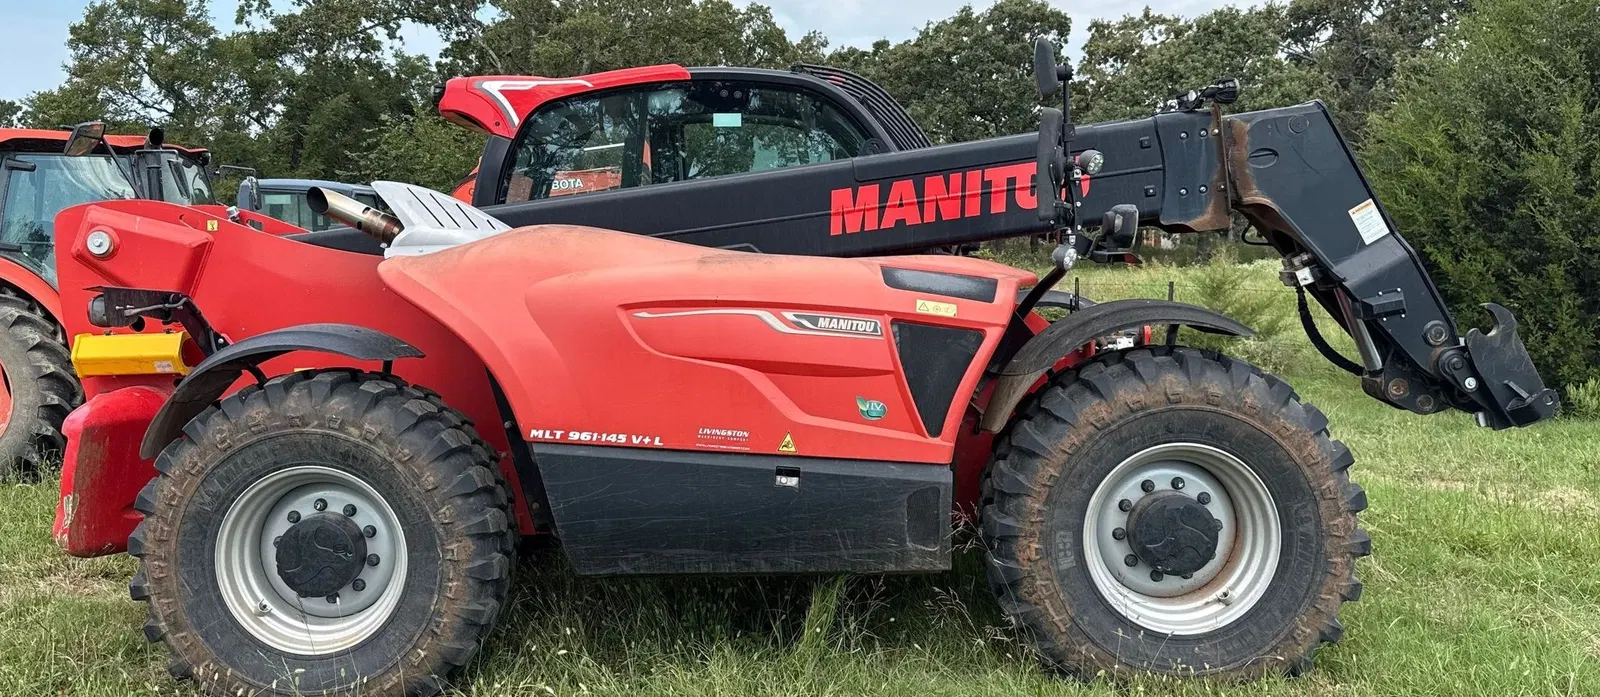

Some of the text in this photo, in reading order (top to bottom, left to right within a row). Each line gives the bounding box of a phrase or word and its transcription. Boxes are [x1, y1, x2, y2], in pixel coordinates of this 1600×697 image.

[829, 156, 1091, 236] MANITO
[817, 317, 875, 332] MANITOU
[530, 428, 565, 440] MLT
[631, 434, 652, 445] V+
[653, 436, 664, 447] L
[698, 427, 750, 438] LIVINGSTON
